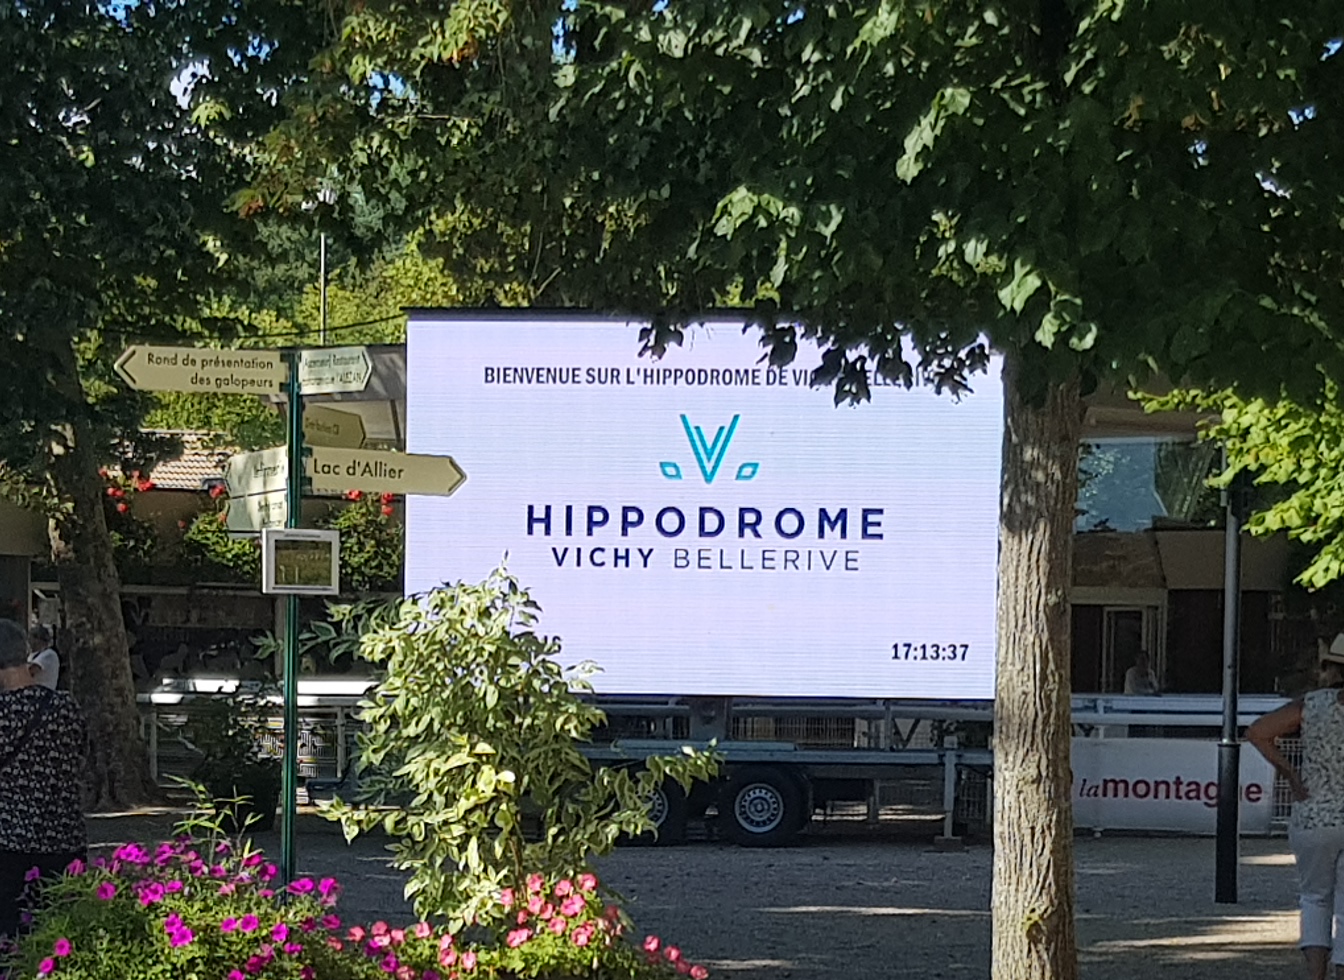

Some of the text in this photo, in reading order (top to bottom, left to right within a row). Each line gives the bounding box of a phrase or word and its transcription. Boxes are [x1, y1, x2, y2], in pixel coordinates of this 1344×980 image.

[147, 352, 273, 370] Rond de présentation
[190, 372, 273, 389] des galopeurs
[484, 366, 581, 384] BIENVENUE
[585, 366, 620, 385] SUR
[625, 366, 761, 386] L'HIPPODROME
[766, 368, 788, 387] DE
[313, 458, 405, 479] Lac d'Allier
[526, 503, 885, 540] HIPPODROME
[551, 546, 860, 571] VICHY BELLERIVE
[891, 642, 970, 661] 17:13:37
[1079, 775, 1263, 808] lamontage
